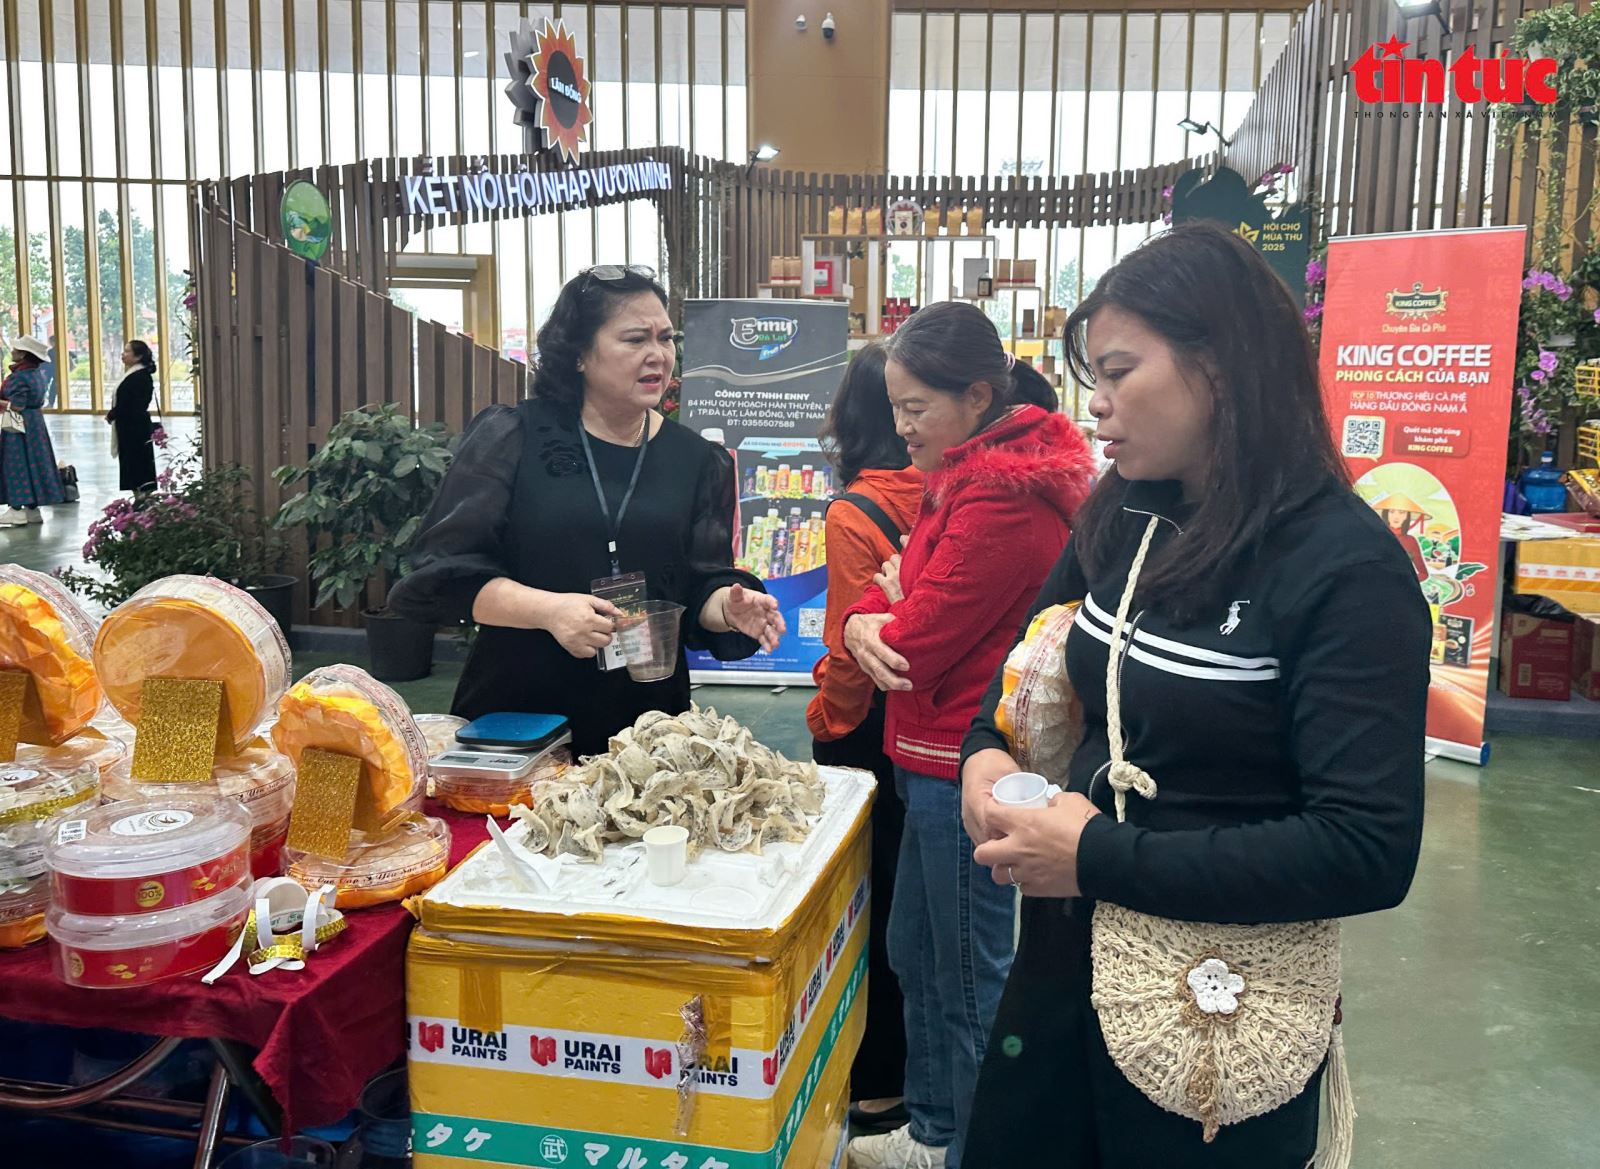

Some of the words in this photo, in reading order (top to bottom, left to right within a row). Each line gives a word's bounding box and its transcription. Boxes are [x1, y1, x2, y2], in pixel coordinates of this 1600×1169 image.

[1262, 243, 1286, 251] 2025
[1336, 345, 1394, 366] KING
[1397, 344, 1492, 367] COFFEE
[1336, 370, 1383, 382] PHONG
[1386, 368, 1423, 383] CÁCH
[1425, 368, 1457, 384] CỦA
[1460, 371, 1490, 387] BẠN
[714, 388, 742, 399] CÔNG
[742, 391, 755, 399] TY
[756, 391, 783, 400] TNHH
[784, 392, 810, 401] ENNY
[1376, 391, 1414, 400] THƯƠNG
[1415, 391, 1434, 401] HIỆU
[1435, 391, 1449, 401] CÀ
[1450, 391, 1467, 402] PHÊ
[699, 399, 718, 407] KHU
[737, 401, 767, 410] HOẠCH
[768, 401, 787, 409] HÀN
[1350, 400, 1378, 410] HÀNG
[1401, 401, 1431, 412] ĐÔNG
[1433, 403, 1458, 412] NAM
[1459, 402, 1467, 413] Á
[739, 409, 757, 417] LÂM
[786, 411, 805, 420] VIỆT
[806, 412, 825, 420] NAM
[1432, 427, 1443, 435] QR
[1408, 444, 1426, 452] KING
[1426, 445, 1454, 453] COFFEE
[451, 1027, 507, 1050] URAI
[451, 1044, 507, 1061] PAINTS
[564, 1040, 621, 1062] URAI
[564, 1057, 621, 1074] PAINTS
[426, 1122, 492, 1152] タケ
